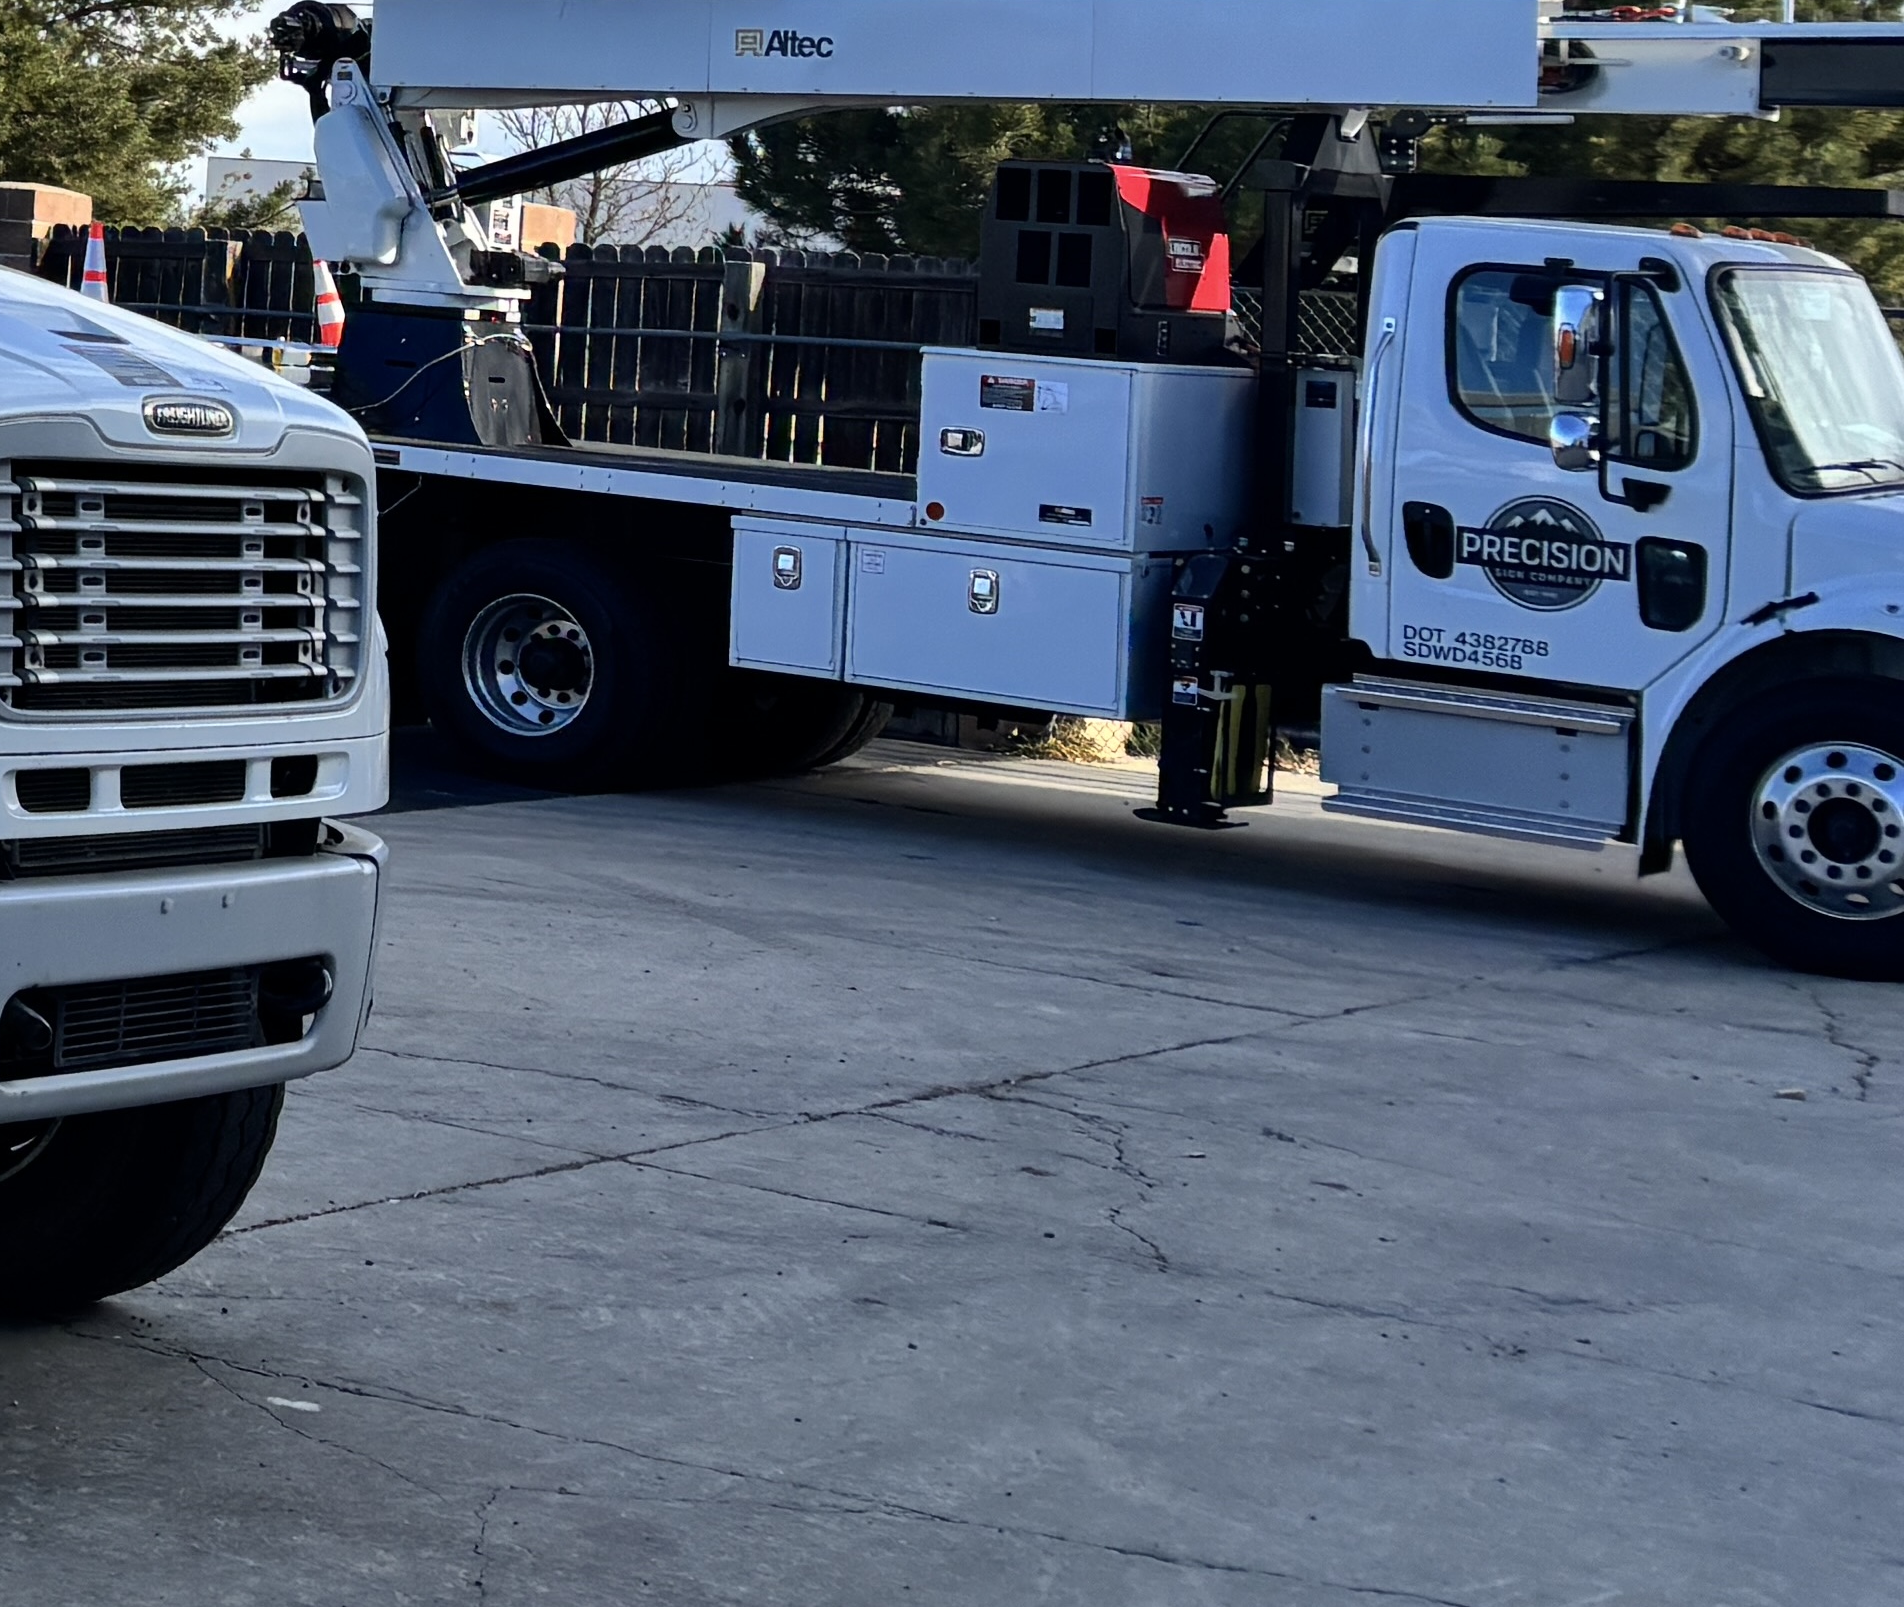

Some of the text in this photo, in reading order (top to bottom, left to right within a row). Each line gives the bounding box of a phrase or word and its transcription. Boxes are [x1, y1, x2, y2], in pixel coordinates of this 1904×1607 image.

[764, 30, 834, 58] Altec
[1462, 531, 1625, 575] PRECISION
[1495, 568, 1591, 587] SIGN COMPANY
[1403, 624, 1446, 643] DOT
